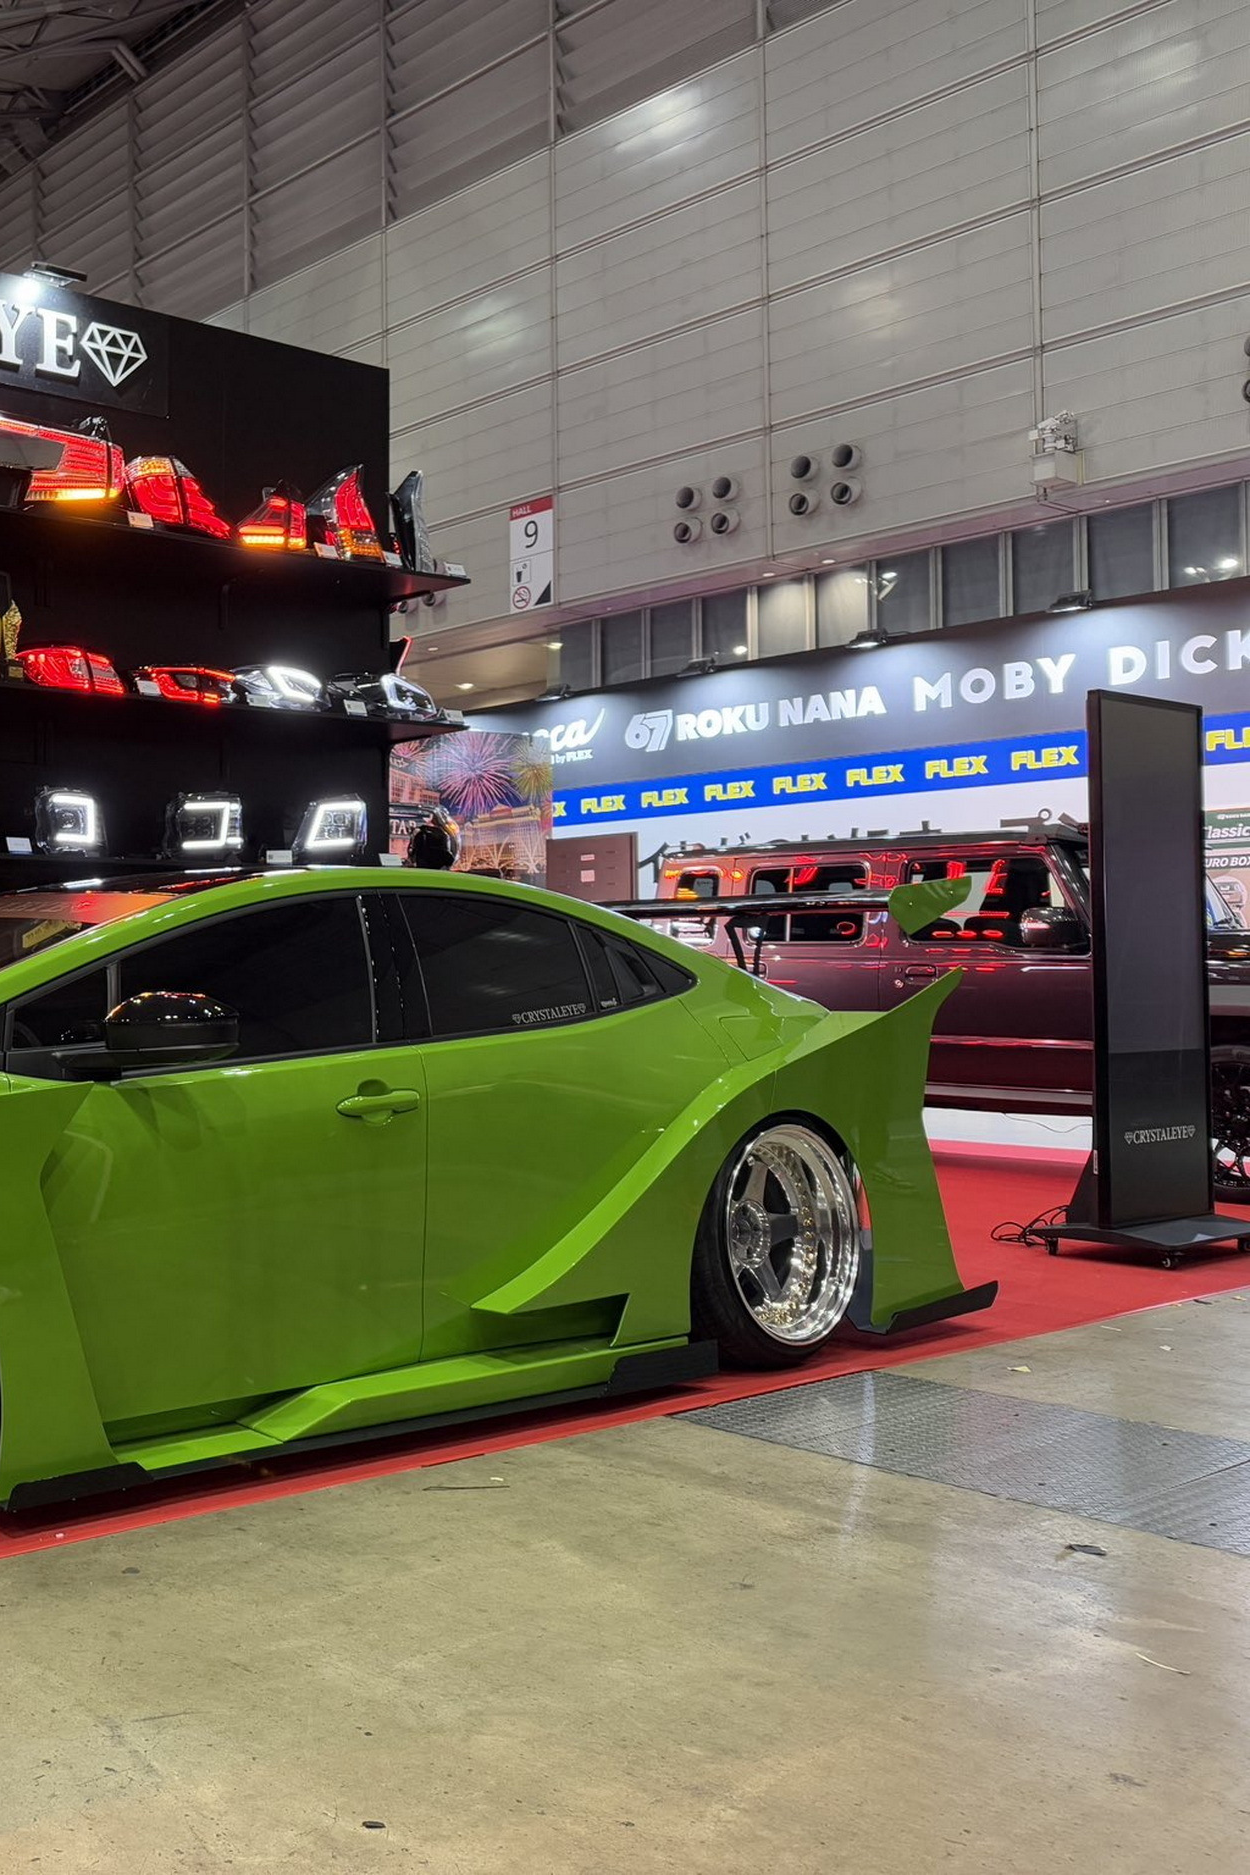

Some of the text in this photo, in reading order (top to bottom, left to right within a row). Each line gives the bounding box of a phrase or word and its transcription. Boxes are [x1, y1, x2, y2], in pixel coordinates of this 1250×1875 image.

[512, 505, 531, 518] HALL
[524, 520, 538, 548] 9
[914, 629, 1250, 712] MOBY DICK
[625, 686, 887, 752] 67 ROKU NANA
[566, 749, 593, 762] FLEX
[581, 794, 626, 815] FLEX
[641, 787, 688, 807] FLEX
[704, 780, 755, 801] FLEX
[773, 772, 827, 794] FLEX
[846, 763, 904, 786] FLEX
[925, 755, 988, 779] FLEX
[1010, 745, 1080, 771] FLEX
[1205, 726, 1250, 751] FL
[1203, 823, 1250, 839] lassic
[1204, 857, 1229, 868] URO
[521, 1004, 580, 1024] CRYSTALEYE
[1133, 1126, 1188, 1144] CRYSTALEYE
